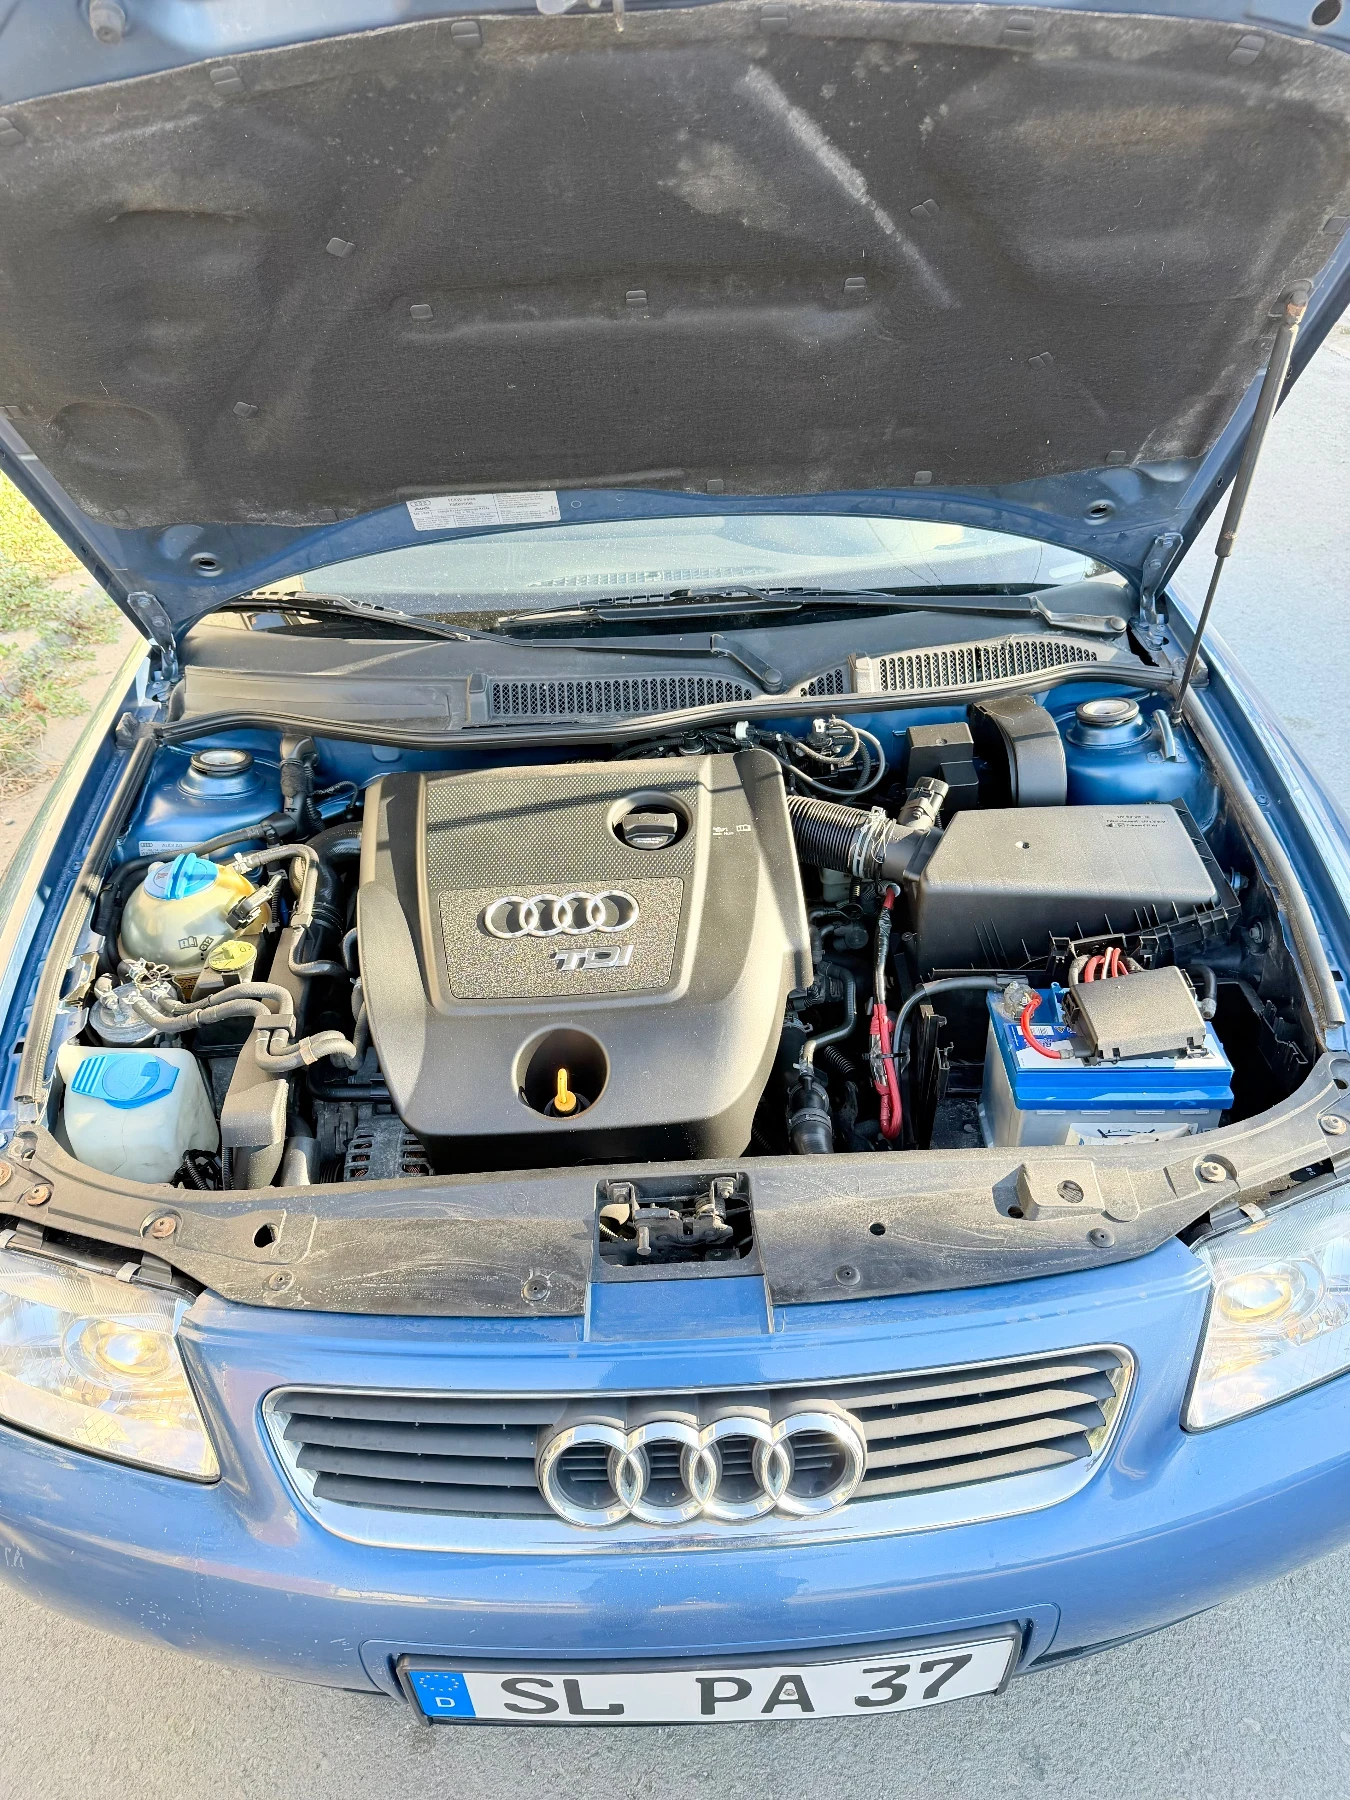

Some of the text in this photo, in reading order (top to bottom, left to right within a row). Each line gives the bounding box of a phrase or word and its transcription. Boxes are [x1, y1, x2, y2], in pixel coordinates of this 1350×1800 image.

[553, 945, 634, 971] TDI
[501, 1653, 973, 1715] SL PA 37
[435, 1696, 456, 1708] D
